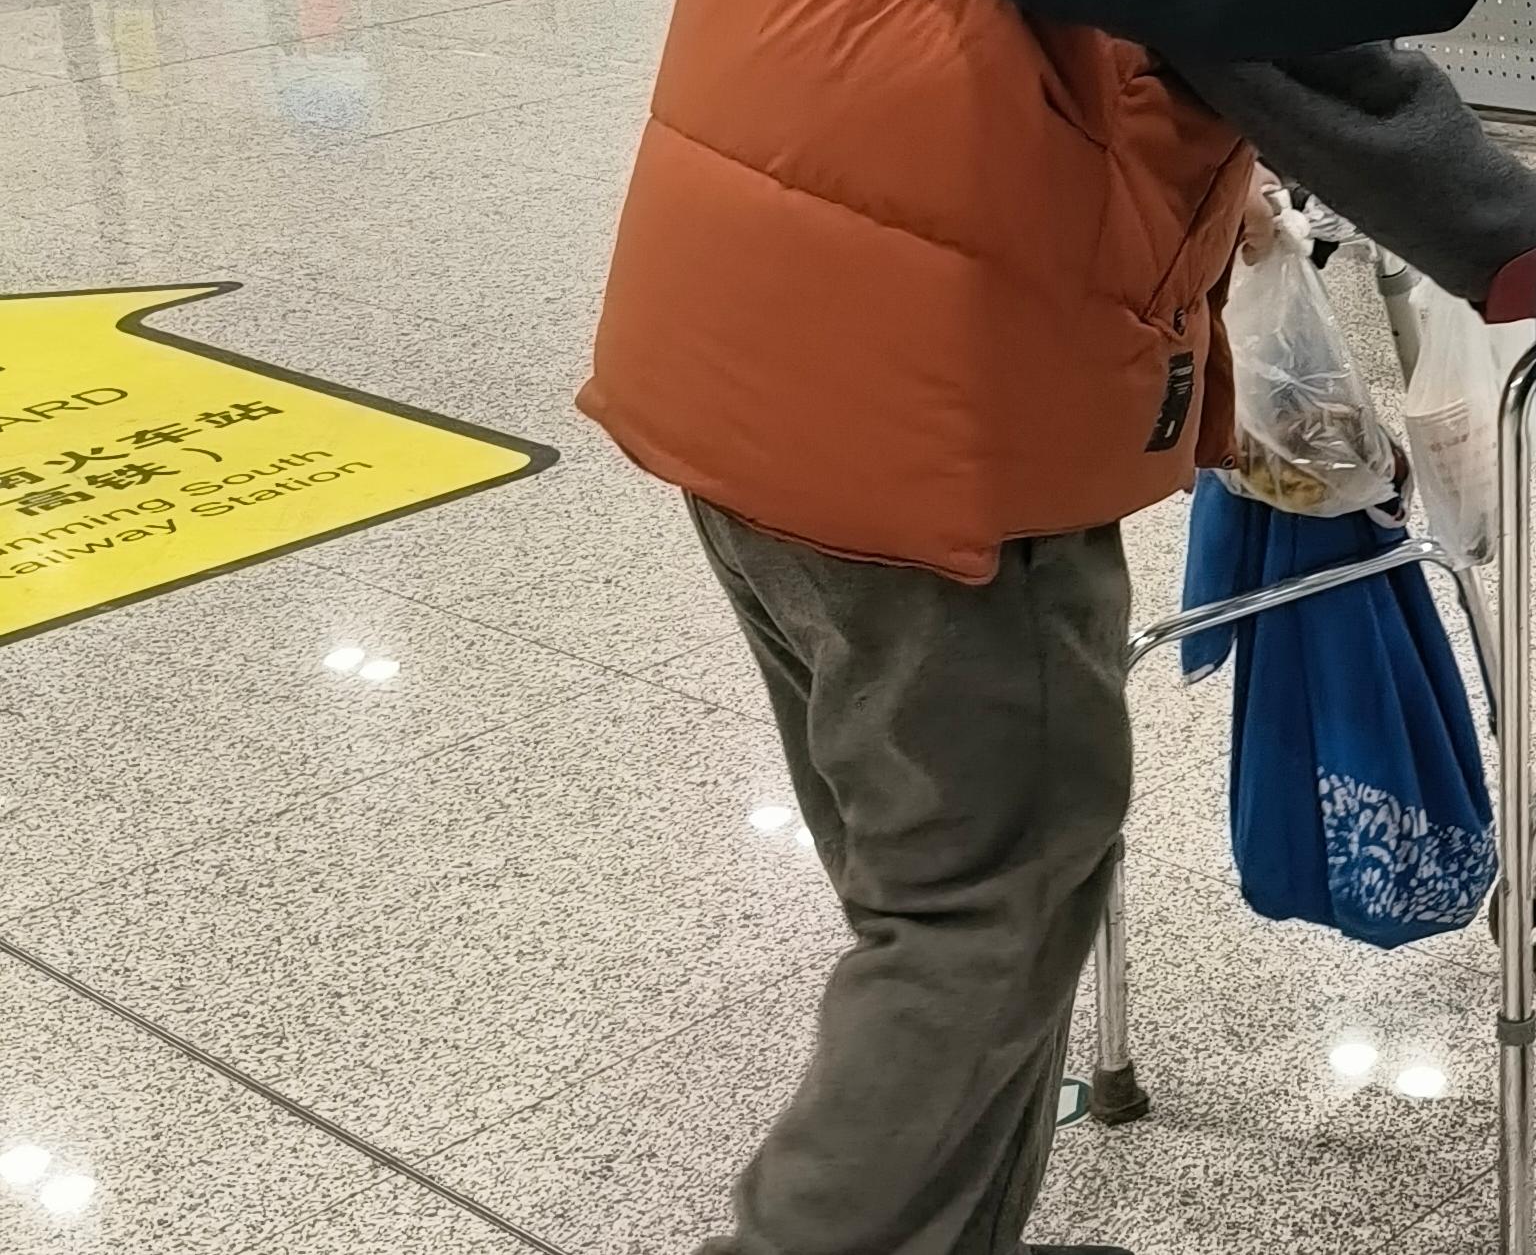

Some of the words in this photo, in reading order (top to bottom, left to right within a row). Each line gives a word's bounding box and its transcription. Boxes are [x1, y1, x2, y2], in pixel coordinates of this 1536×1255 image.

[0, 498, 175, 554] nming
[180, 451, 333, 496] South
[0, 518, 177, 578] ailway
[190, 462, 373, 517] Station
